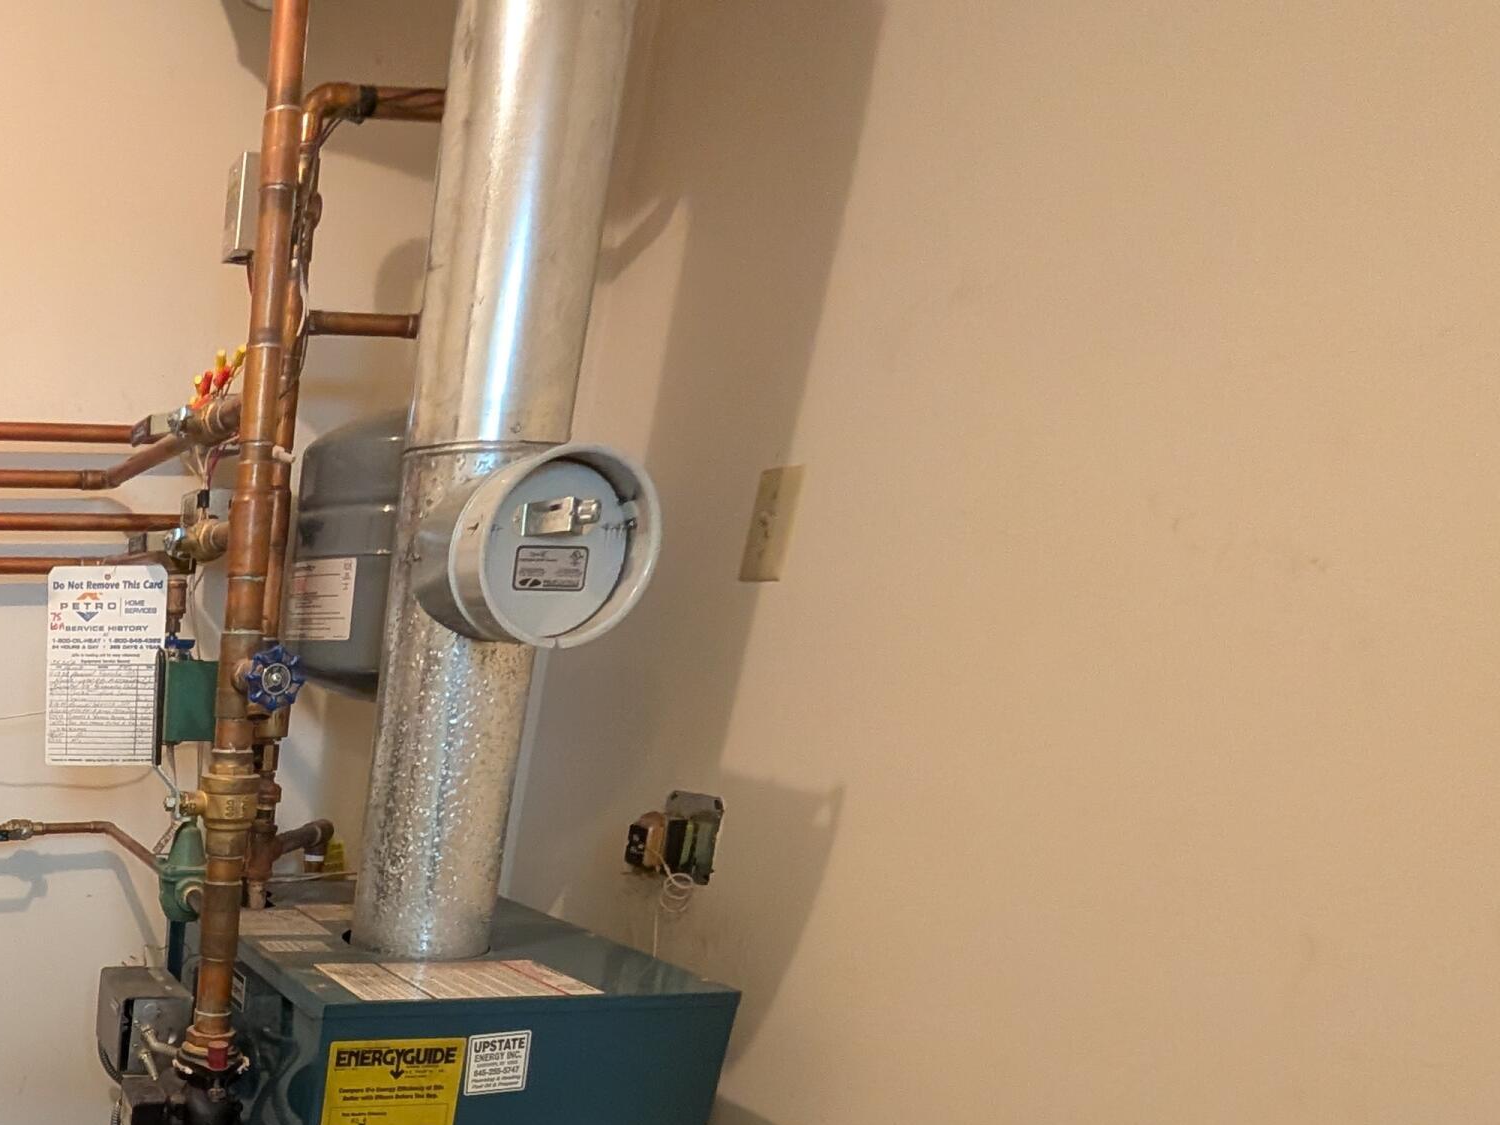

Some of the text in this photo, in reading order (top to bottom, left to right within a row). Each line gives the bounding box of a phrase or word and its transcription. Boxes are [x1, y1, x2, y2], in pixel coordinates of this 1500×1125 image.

[53, 580, 164, 590] Do Not Remove This Card
[60, 602, 117, 610] PETRO
[473, 1037, 525, 1053] UPSTATE
[335, 1047, 457, 1068] ENERGYGUIDE
[474, 1052, 505, 1062] ENERGY
